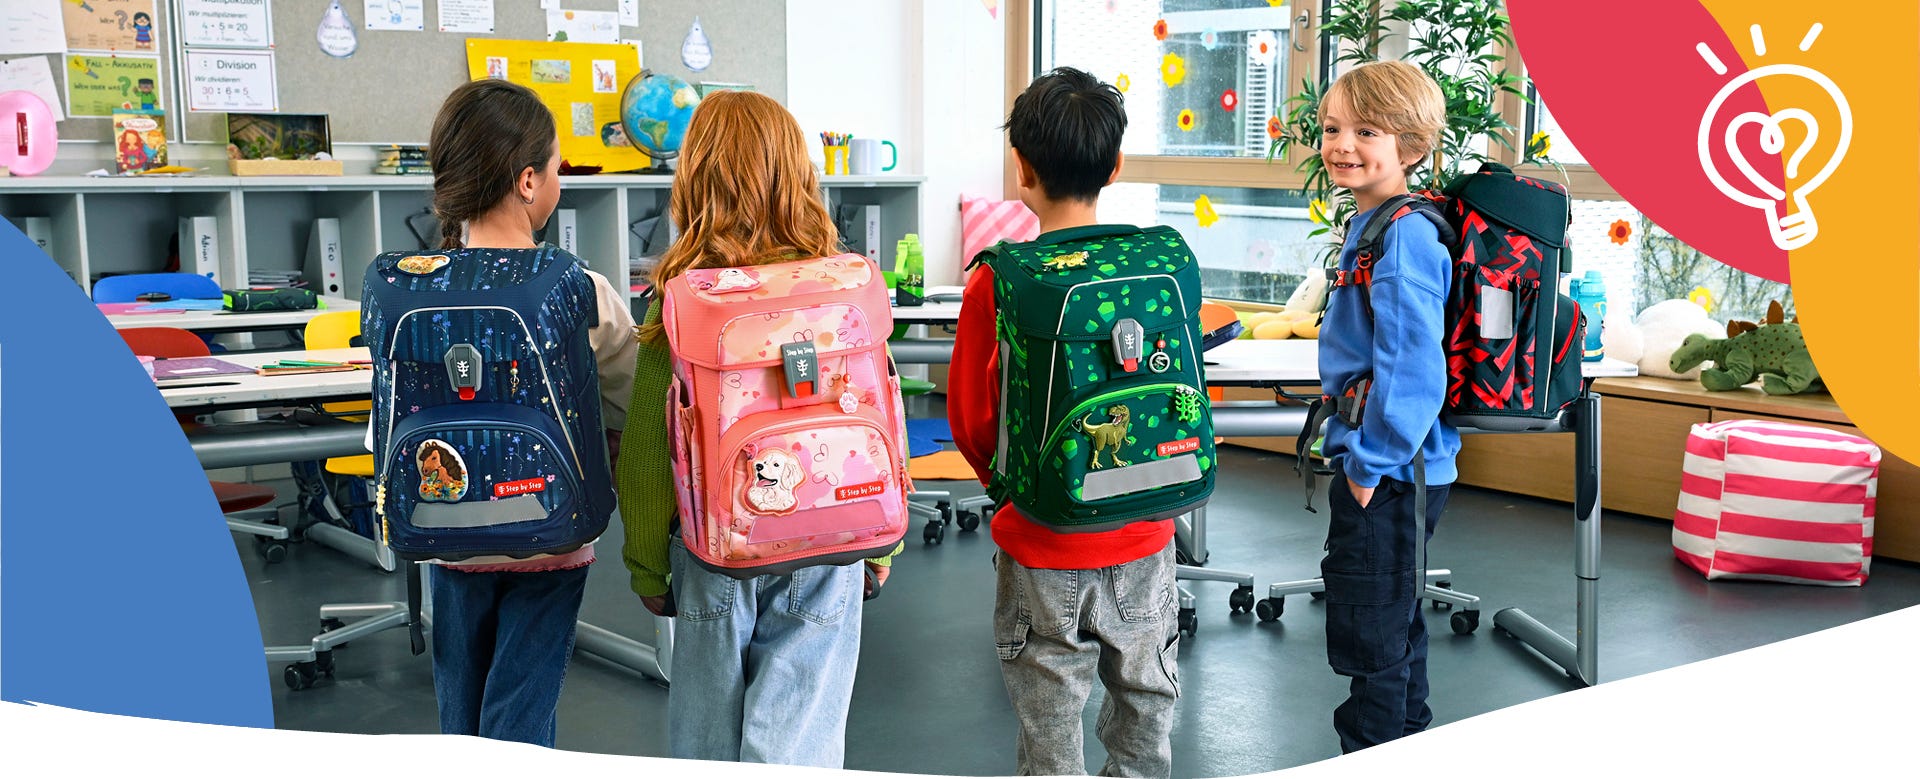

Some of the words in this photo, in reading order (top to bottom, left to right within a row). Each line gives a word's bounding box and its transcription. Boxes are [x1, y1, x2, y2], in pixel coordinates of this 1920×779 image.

[216, 60, 256, 70] Division
[505, 484, 520, 492] Step
[520, 482, 528, 491] by
[529, 482, 542, 490] Step
[868, 485, 882, 493] Step
